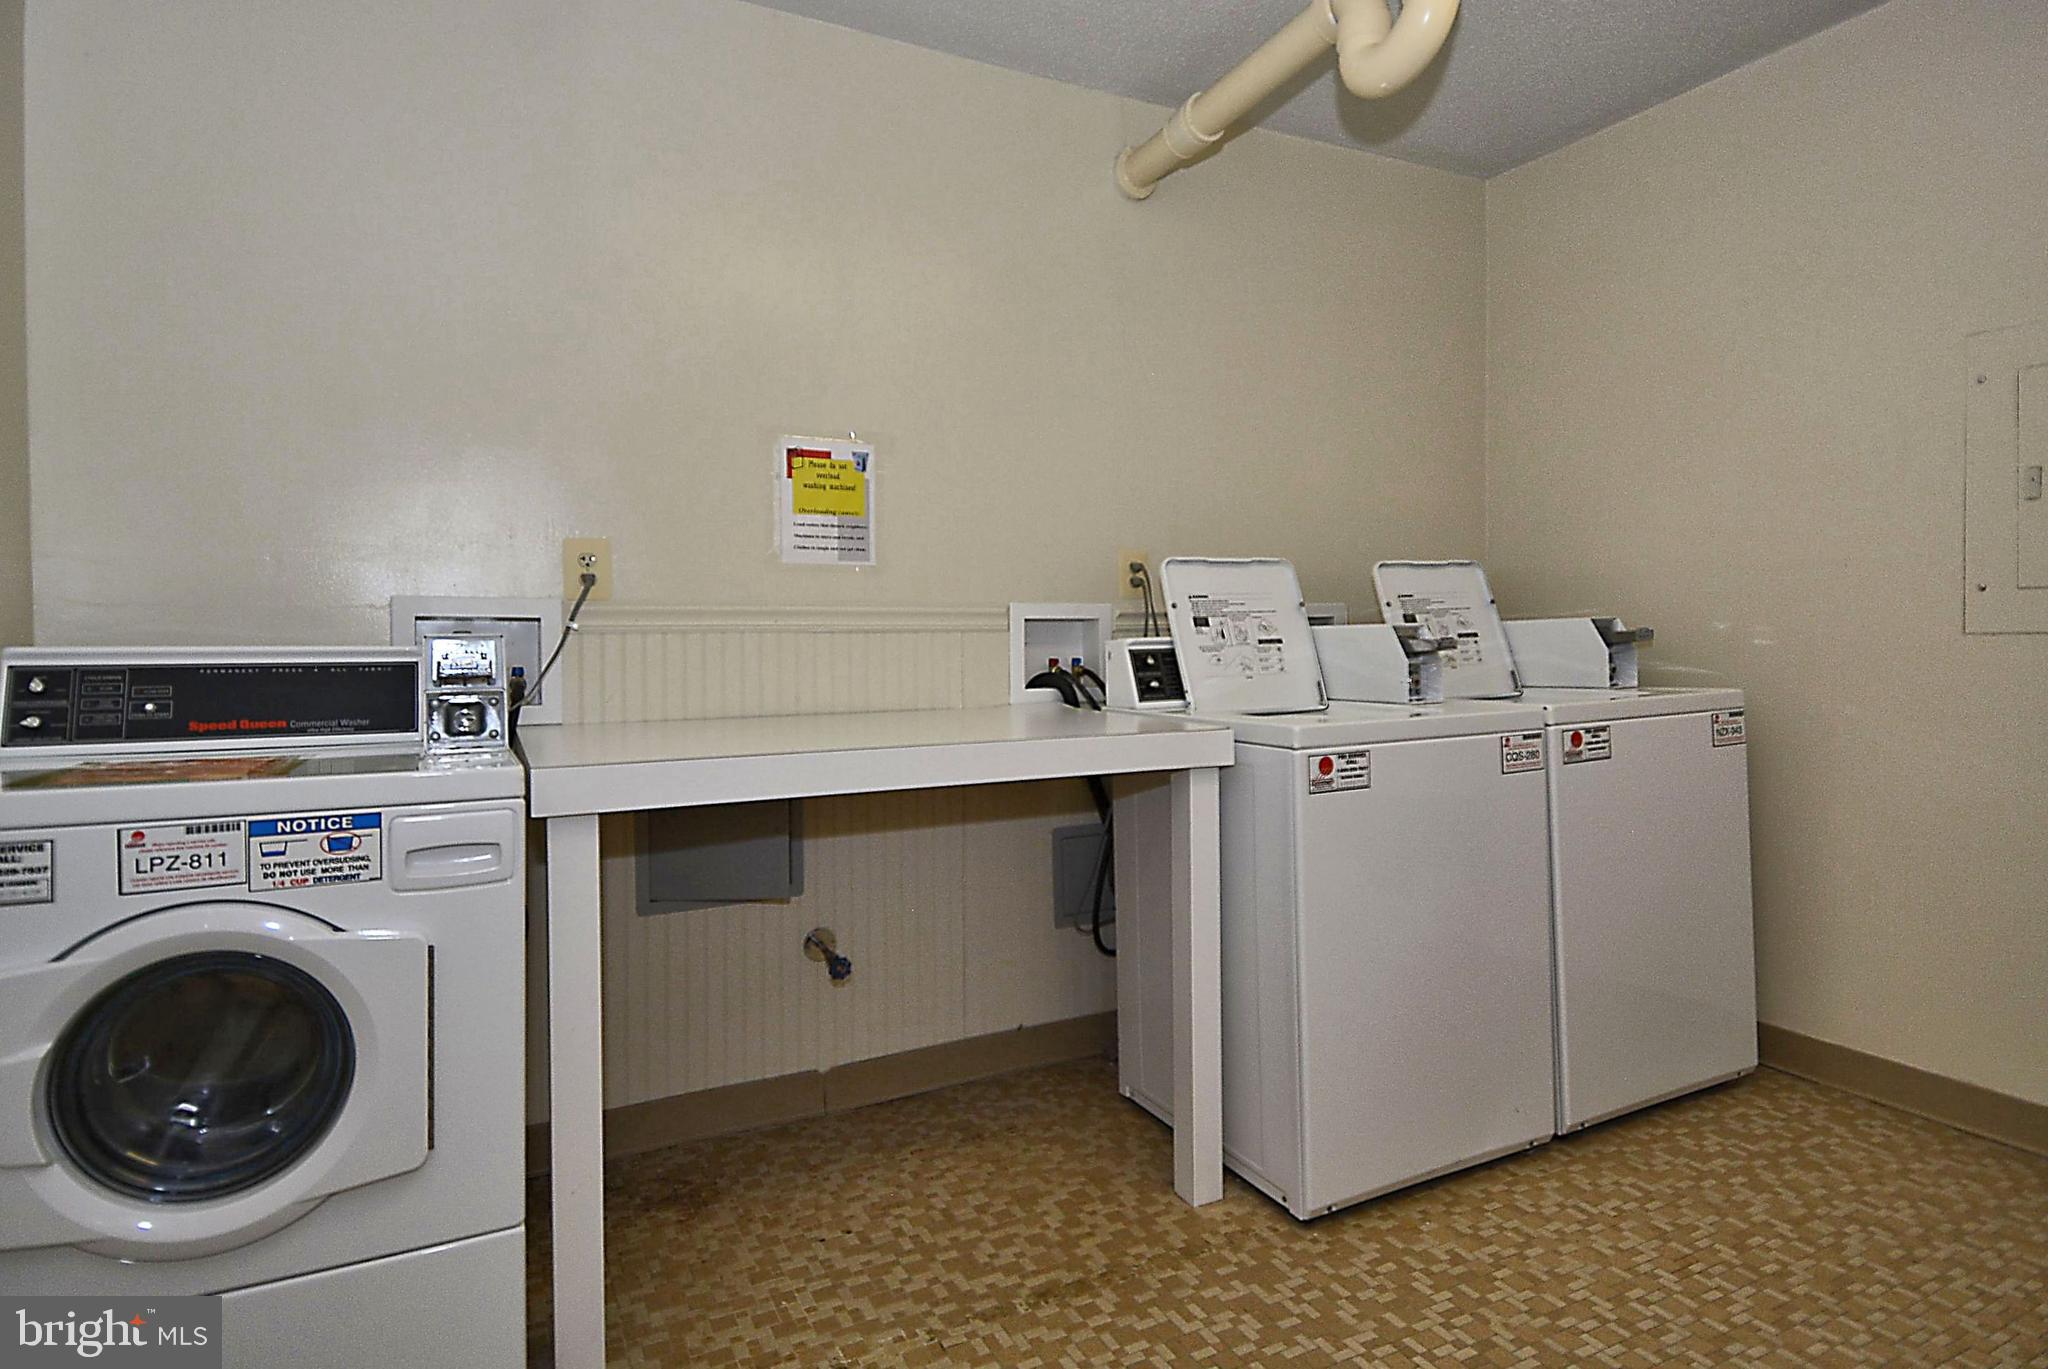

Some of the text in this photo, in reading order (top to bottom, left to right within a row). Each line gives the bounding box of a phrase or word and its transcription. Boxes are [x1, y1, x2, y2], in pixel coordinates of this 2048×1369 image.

[803, 482, 826, 491] washing
[188, 718, 370, 732] Speed Queen Commercial Washer
[277, 816, 353, 833] NOTICE
[135, 851, 226, 874] LPZ-811
[260, 863, 271, 871] TO
[273, 859, 310, 870] PREVENT
[263, 863, 369, 880] DO NOT USE MORE THAN
[272, 873, 361, 888] 1/4 CUP DETERGENT
